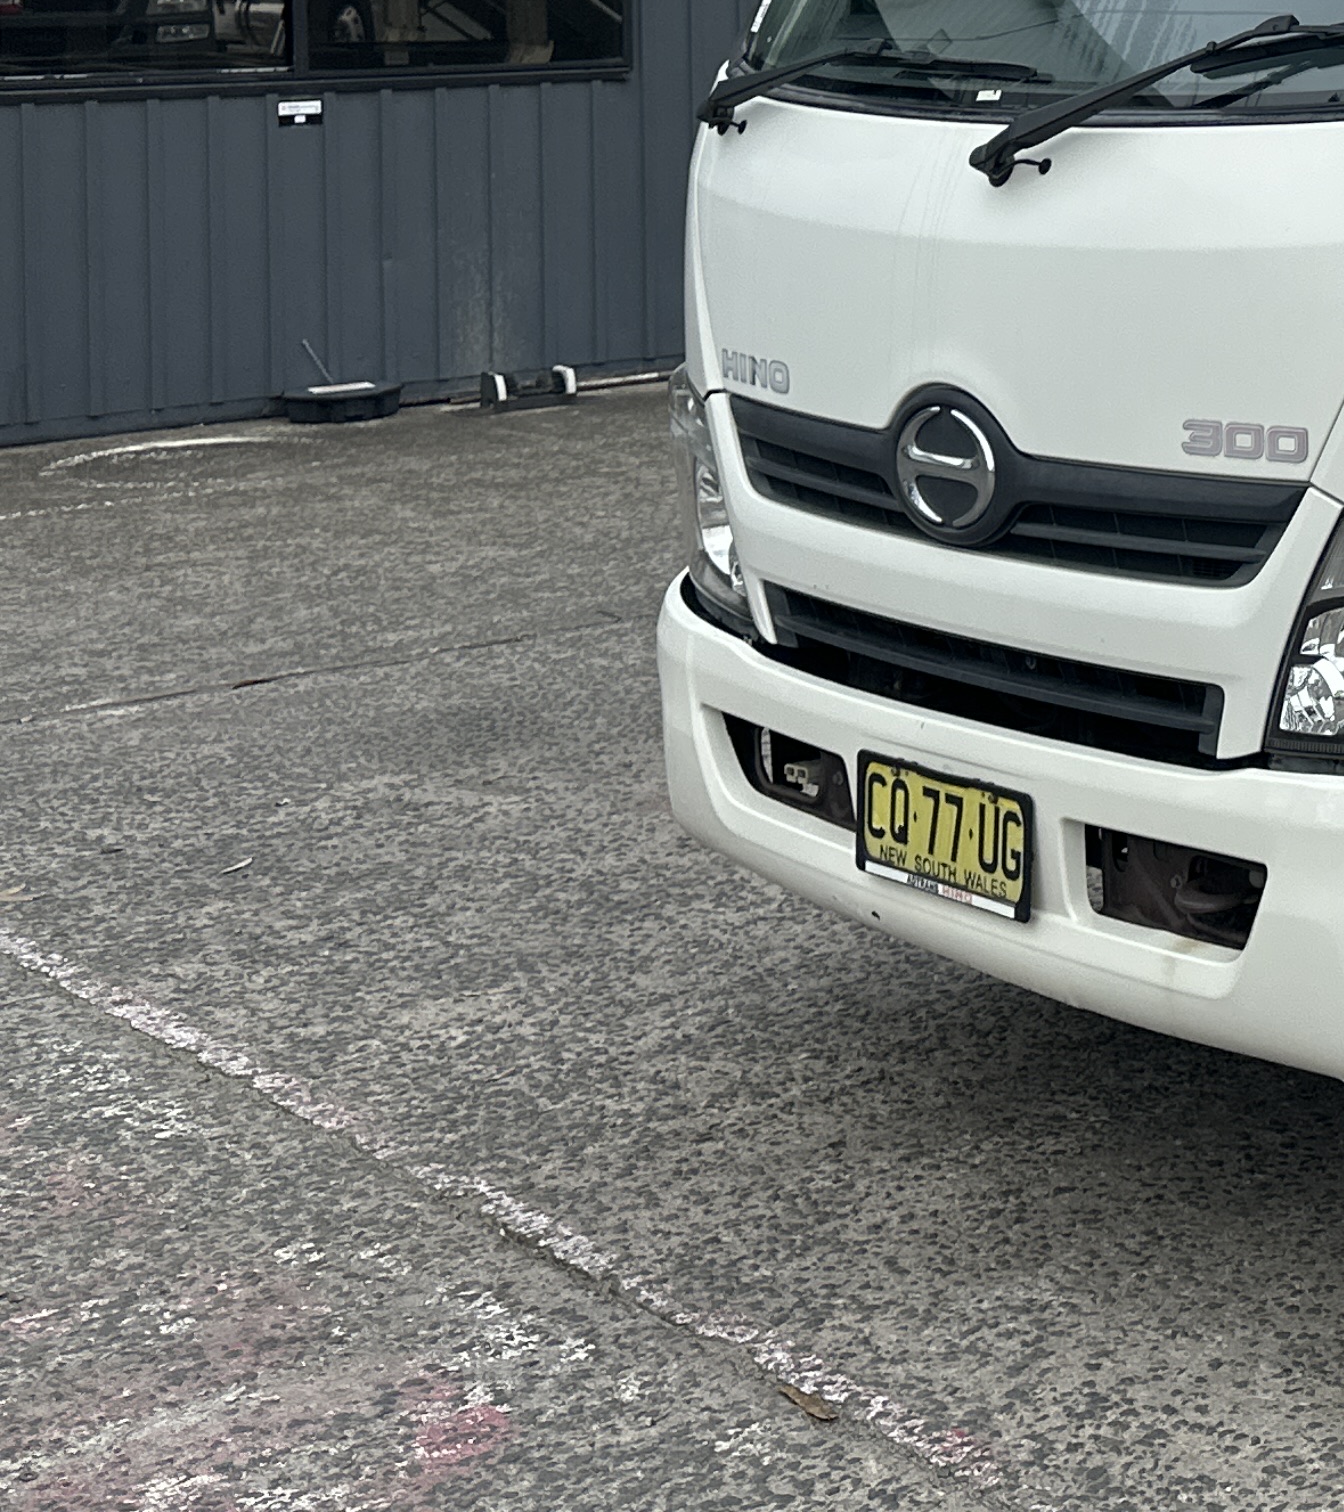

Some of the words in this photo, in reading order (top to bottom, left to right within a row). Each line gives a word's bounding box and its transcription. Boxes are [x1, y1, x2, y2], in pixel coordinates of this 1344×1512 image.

[721, 348, 790, 394] HINO
[1181, 419, 1309, 464] 300
[880, 843, 907, 867] NEW
[914, 854, 957, 884] SOUTH
[963, 868, 1007, 898] WALES
